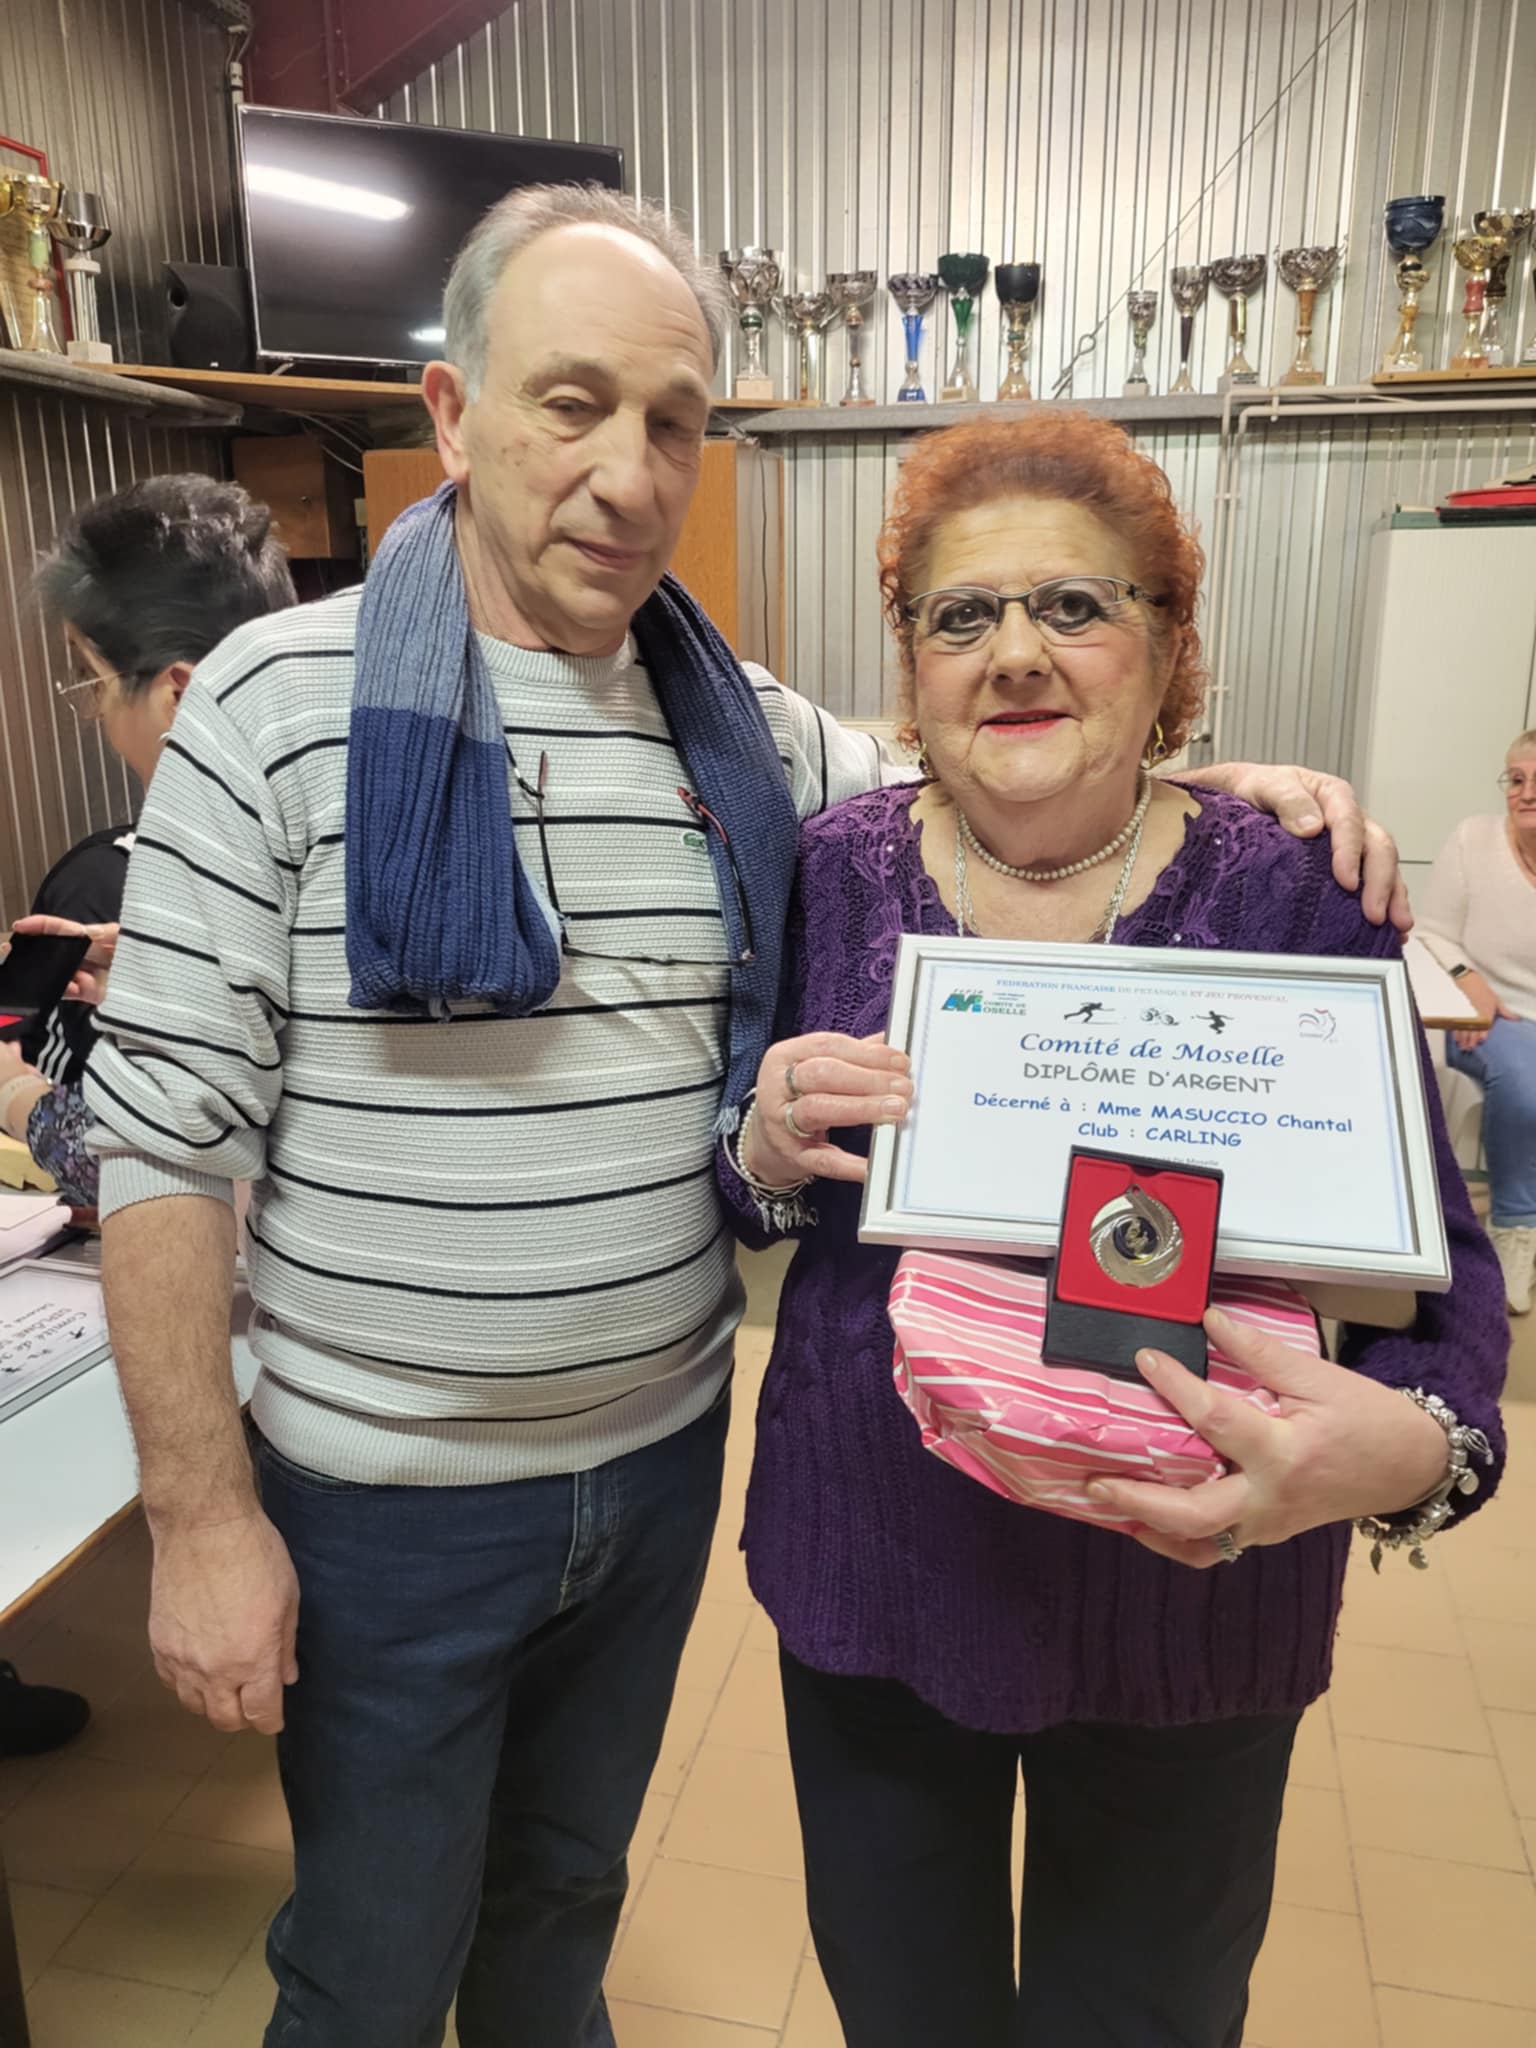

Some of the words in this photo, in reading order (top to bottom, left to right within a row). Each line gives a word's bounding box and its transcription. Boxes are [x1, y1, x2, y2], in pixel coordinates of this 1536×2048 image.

[1020, 1033, 1120, 1057] Comité
[1129, 1038, 1162, 1059] de
[1172, 1042, 1285, 1067] Moselle
[1023, 1061, 1137, 1085] DIPLÔME
[1149, 1070, 1277, 1094] D'ARGENT
[973, 1092, 1051, 1111] Décerné
[1060, 1097, 1071, 1112] à
[1097, 1101, 1142, 1117] Mme
[1151, 1105, 1268, 1126] MASUCCIO
[1277, 1113, 1353, 1133] Chantal
[1078, 1122, 1118, 1138] Club
[1145, 1127, 1242, 1147] CARLING
